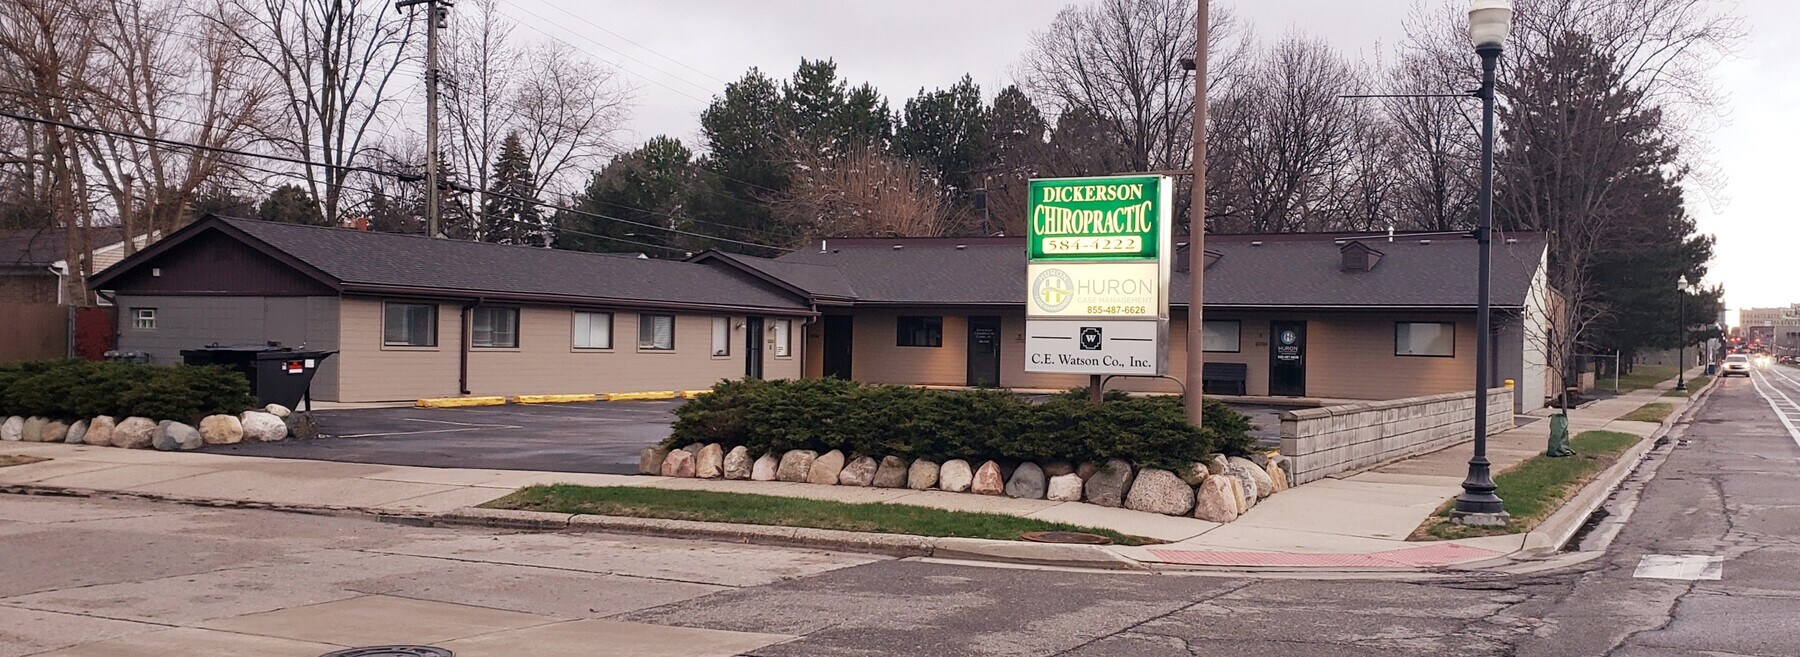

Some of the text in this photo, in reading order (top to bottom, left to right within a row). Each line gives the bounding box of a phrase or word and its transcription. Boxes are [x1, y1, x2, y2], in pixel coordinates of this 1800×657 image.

[1042, 184, 1143, 203] DICKERSON
[1033, 200, 1152, 235] CHIROPRACTIC
[1049, 238, 1135, 251] 584-4222
[1039, 269, 1069, 282] HURON
[1077, 279, 1153, 295] HURON
[1098, 296, 1153, 304] MANAGEMENT
[1087, 305, 1146, 315] 855-487-6626
[1086, 335, 1096, 343] W
[1031, 353, 1152, 368] C.E. Watson Co., Inc.
